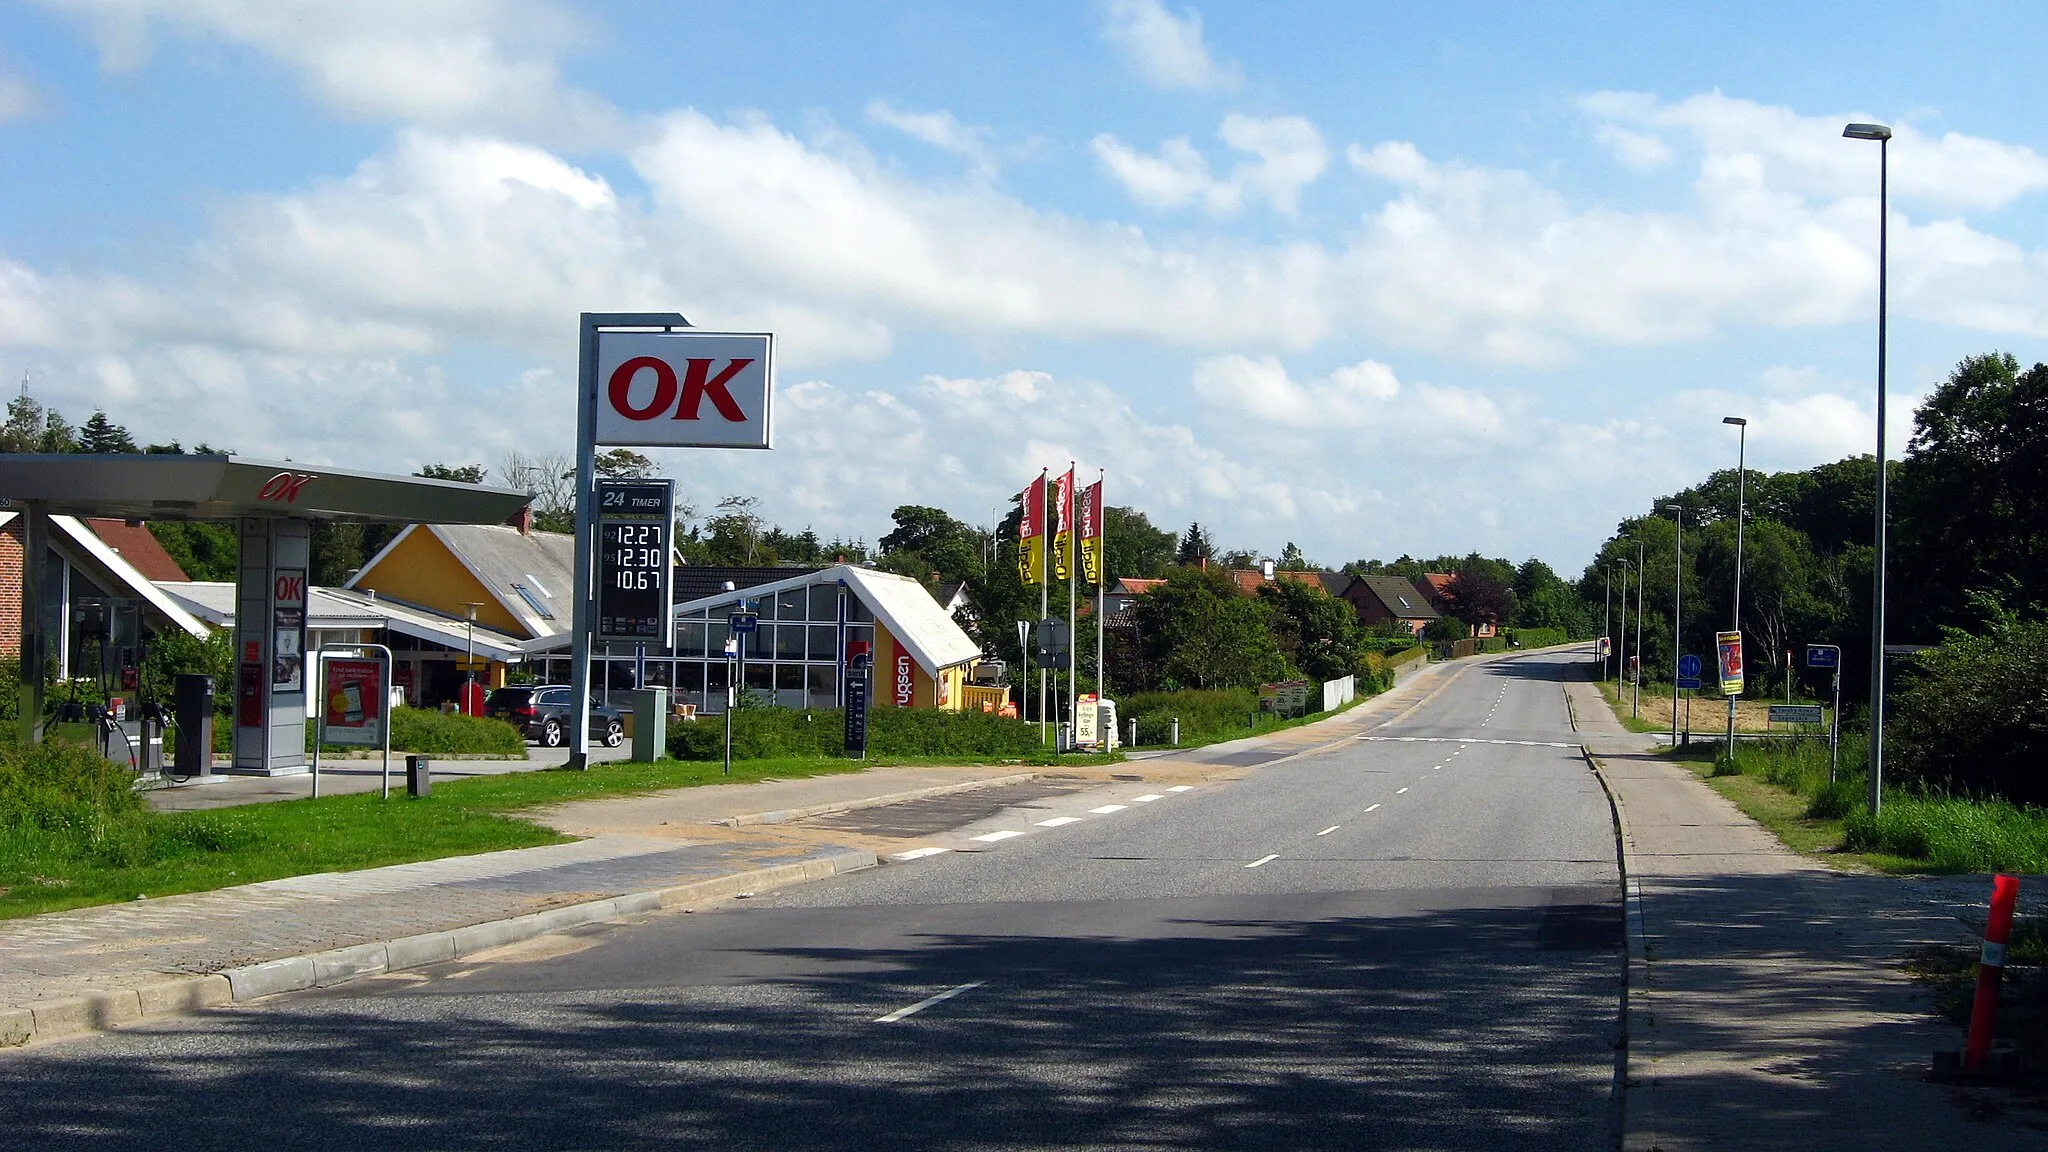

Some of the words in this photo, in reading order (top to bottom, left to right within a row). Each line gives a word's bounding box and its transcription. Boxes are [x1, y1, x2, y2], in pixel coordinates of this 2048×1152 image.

[607, 356, 755, 422] OK
[257, 472, 318, 503] OK
[602, 491, 625, 507] 24
[631, 497, 661, 508] TIMER
[604, 531, 616, 541] 92
[618, 525, 661, 545] 12.27
[604, 553, 616, 563] 95
[617, 548, 661, 568] 12.30
[276, 575, 304, 601] OK
[616, 570, 661, 590] 10.67
